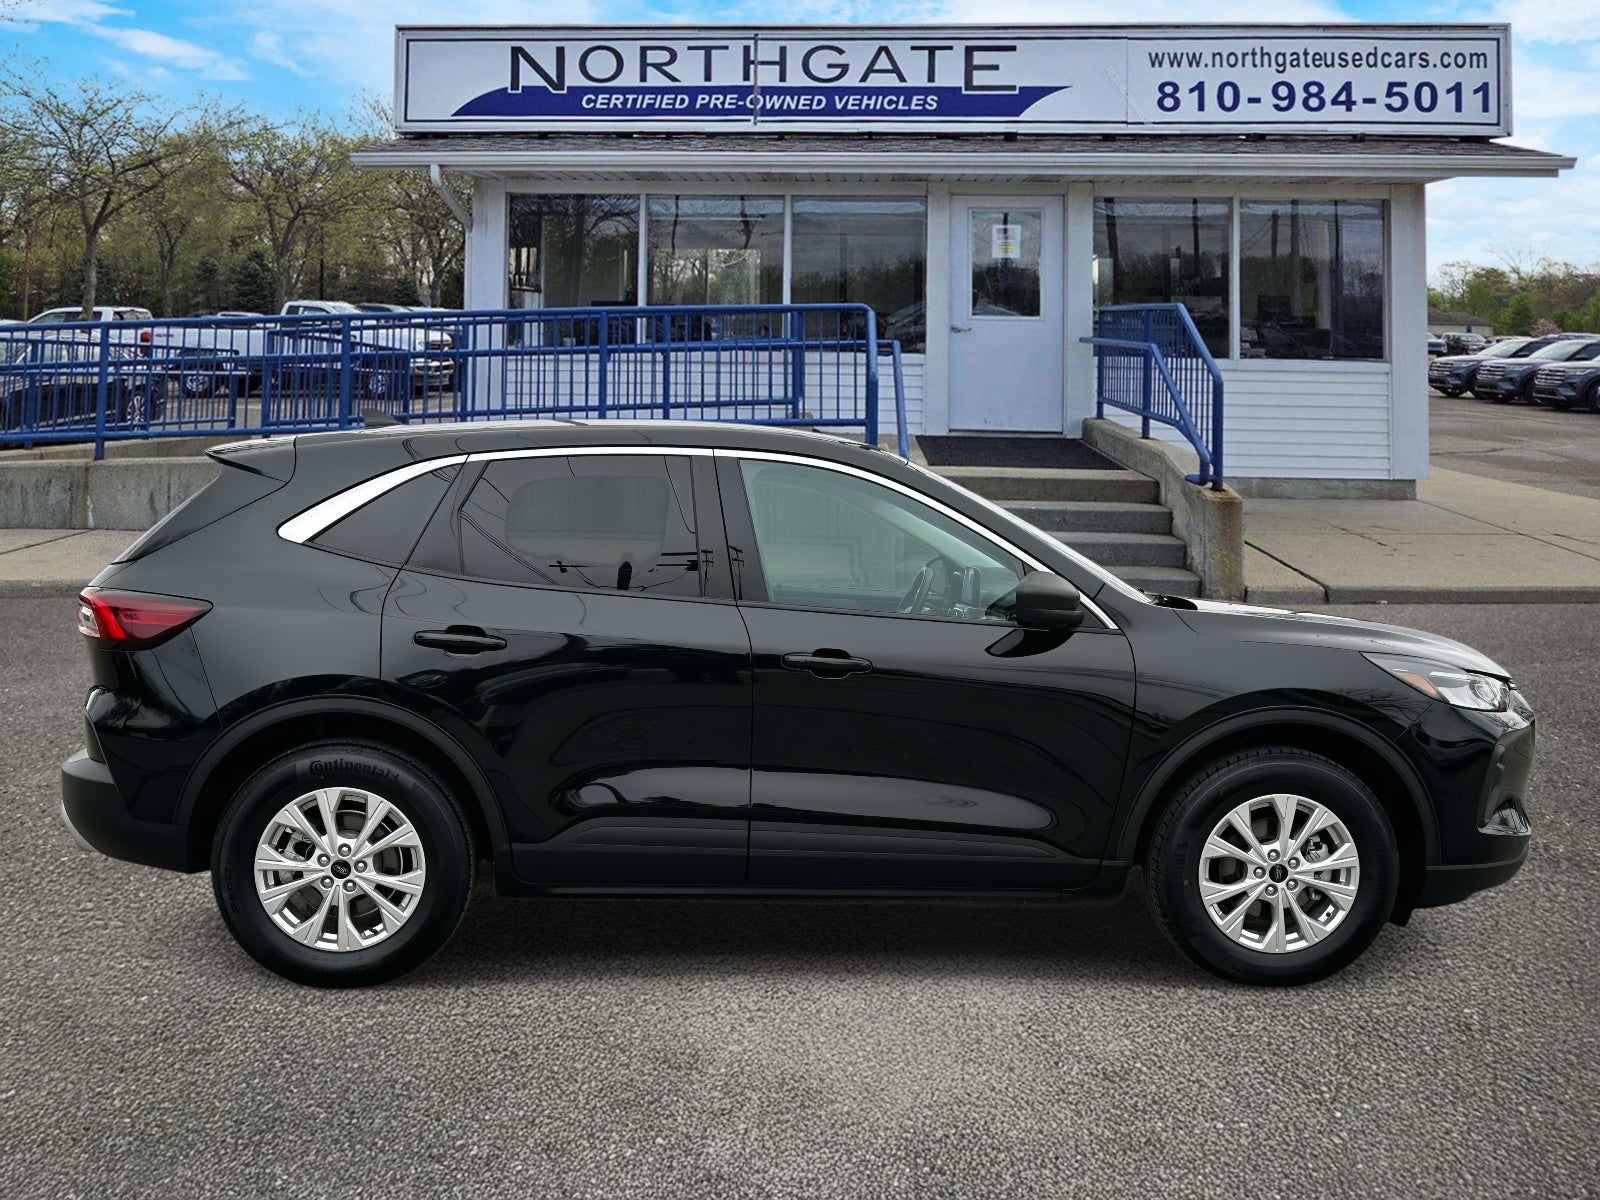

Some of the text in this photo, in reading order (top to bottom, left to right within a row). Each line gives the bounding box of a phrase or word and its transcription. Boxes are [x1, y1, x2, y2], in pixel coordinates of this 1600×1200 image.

[509, 45, 1017, 92] NORTHGATE
[1148, 46, 1488, 73] www.northgateusedcars.com
[581, 93, 938, 111] CERTIFIED PRE-OWNED VEHICLES
[1157, 80, 1491, 113] 810-984-5011
